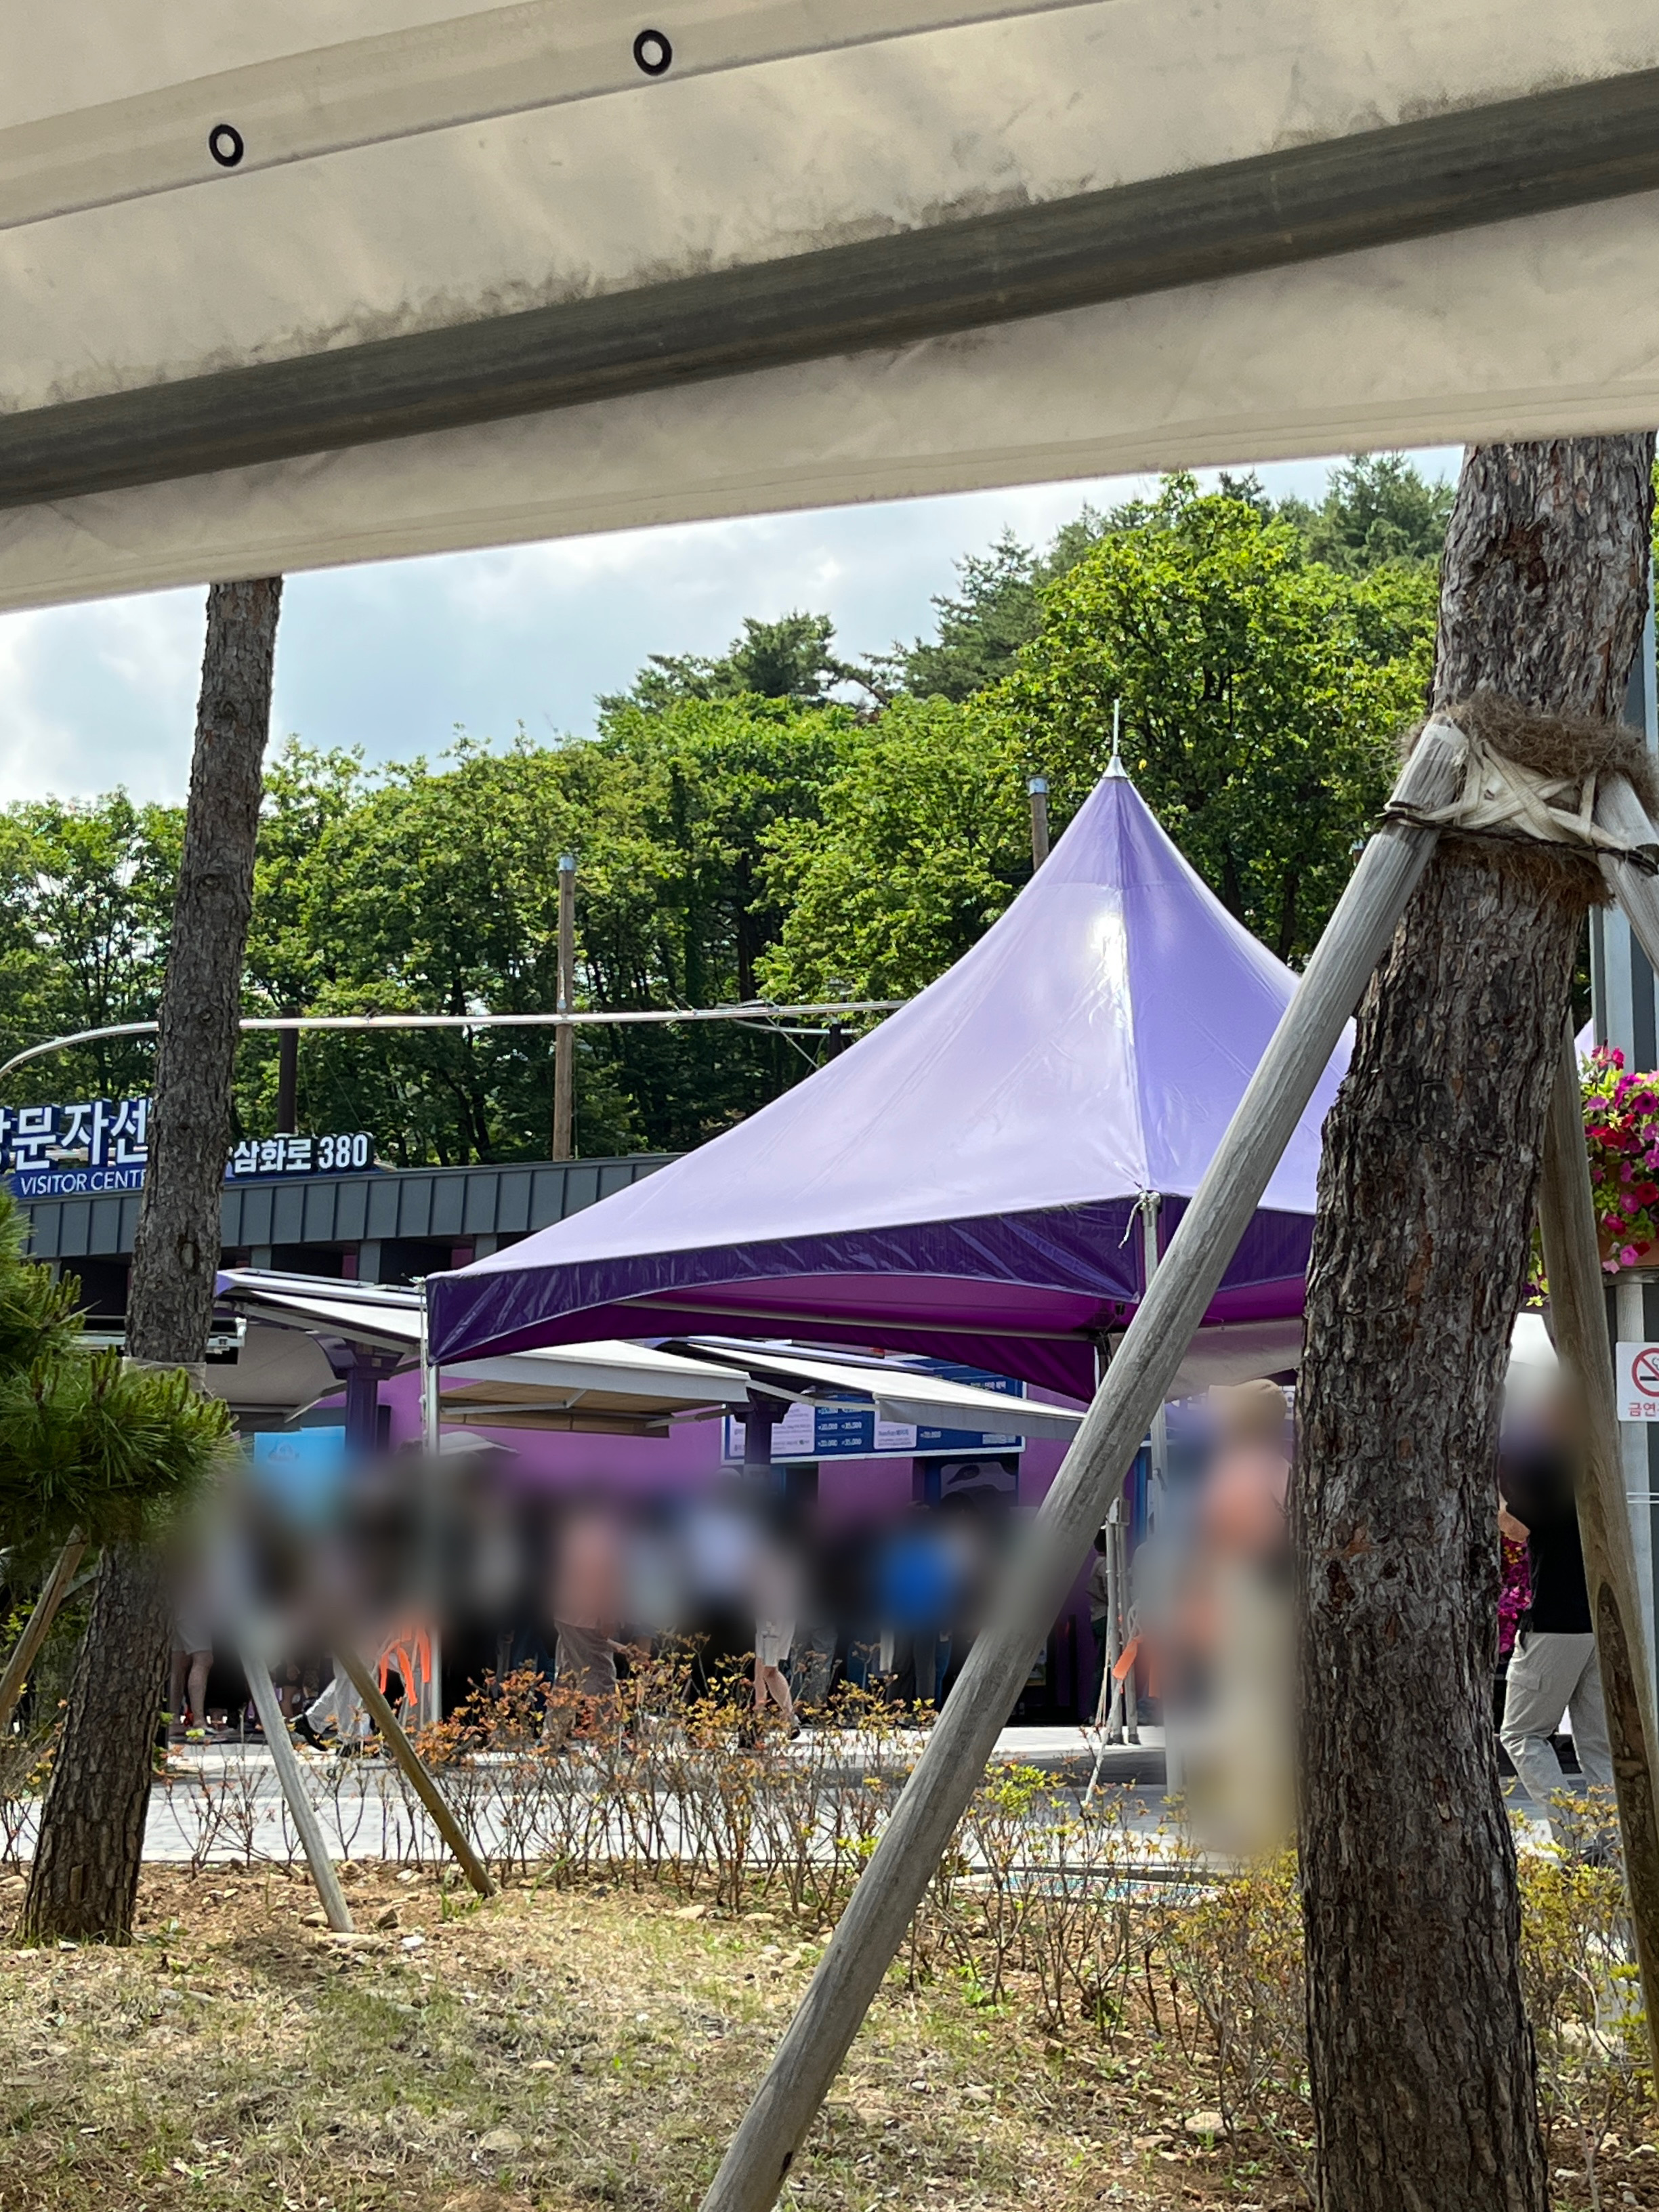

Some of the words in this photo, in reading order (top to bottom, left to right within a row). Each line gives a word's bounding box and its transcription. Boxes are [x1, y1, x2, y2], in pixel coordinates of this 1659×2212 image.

[233, 1138, 312, 1173] 삼화로
[318, 1133, 369, 1169] 380
[20, 1172, 87, 1196] VISITOR
[1628, 1402, 1659, 1417] 금연
